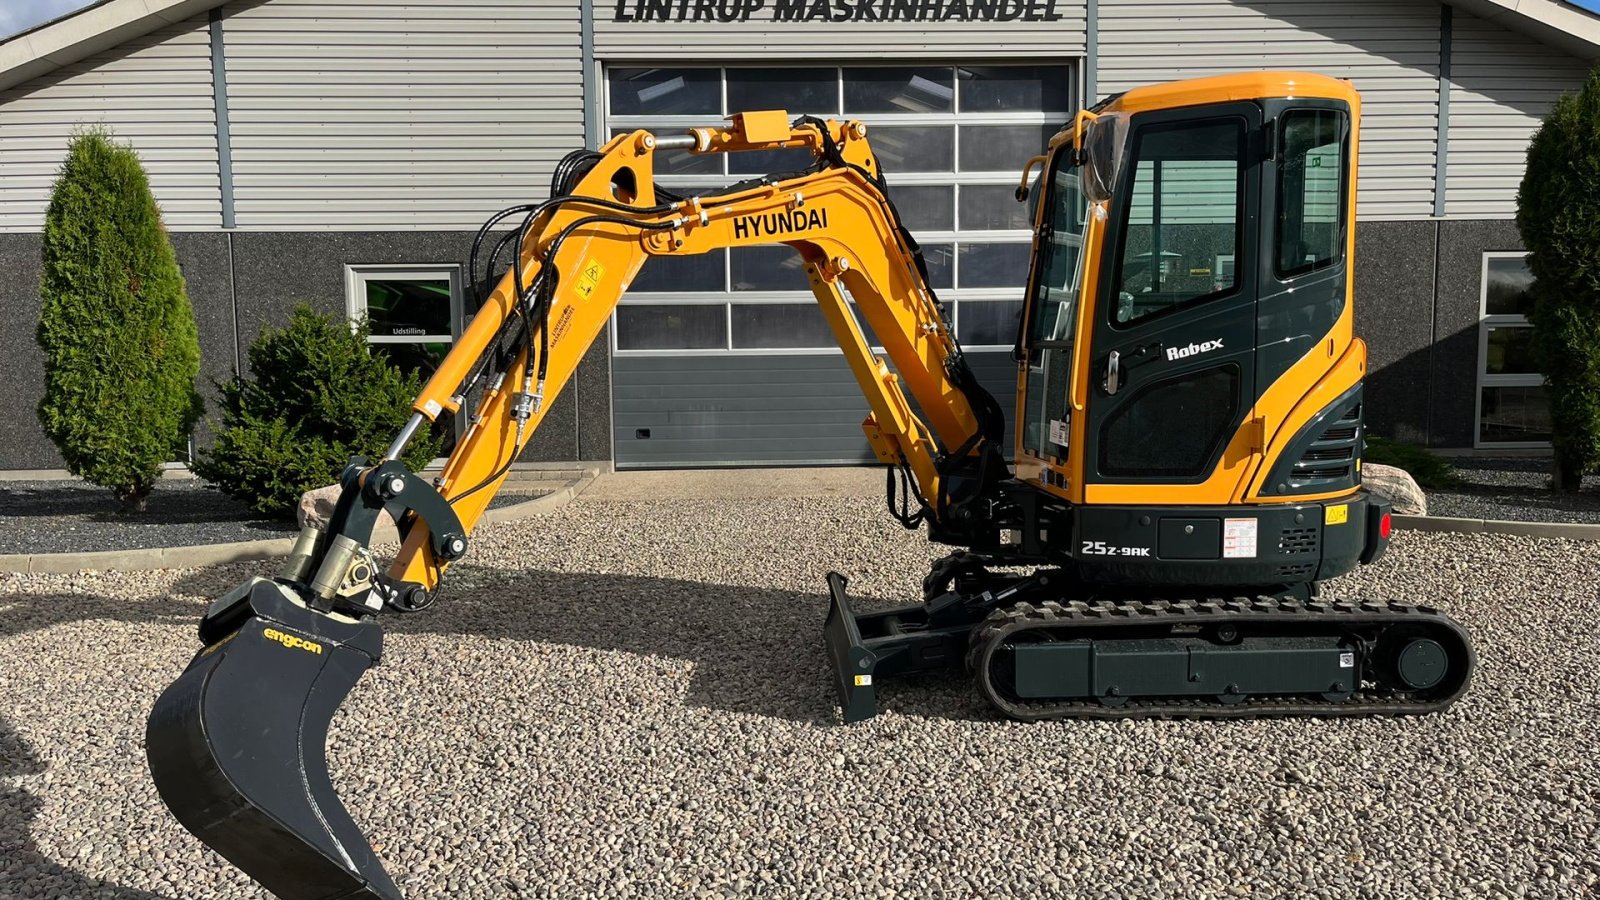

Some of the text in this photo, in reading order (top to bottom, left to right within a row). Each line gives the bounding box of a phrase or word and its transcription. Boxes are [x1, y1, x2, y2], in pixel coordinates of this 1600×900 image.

[612, 0, 1063, 22] LINTRUP MASKINHANDEL
[733, 207, 828, 239] HYUNDAI
[392, 327, 426, 337] Udstilling
[1166, 337, 1225, 361] Robex
[263, 628, 322, 655] engcon
